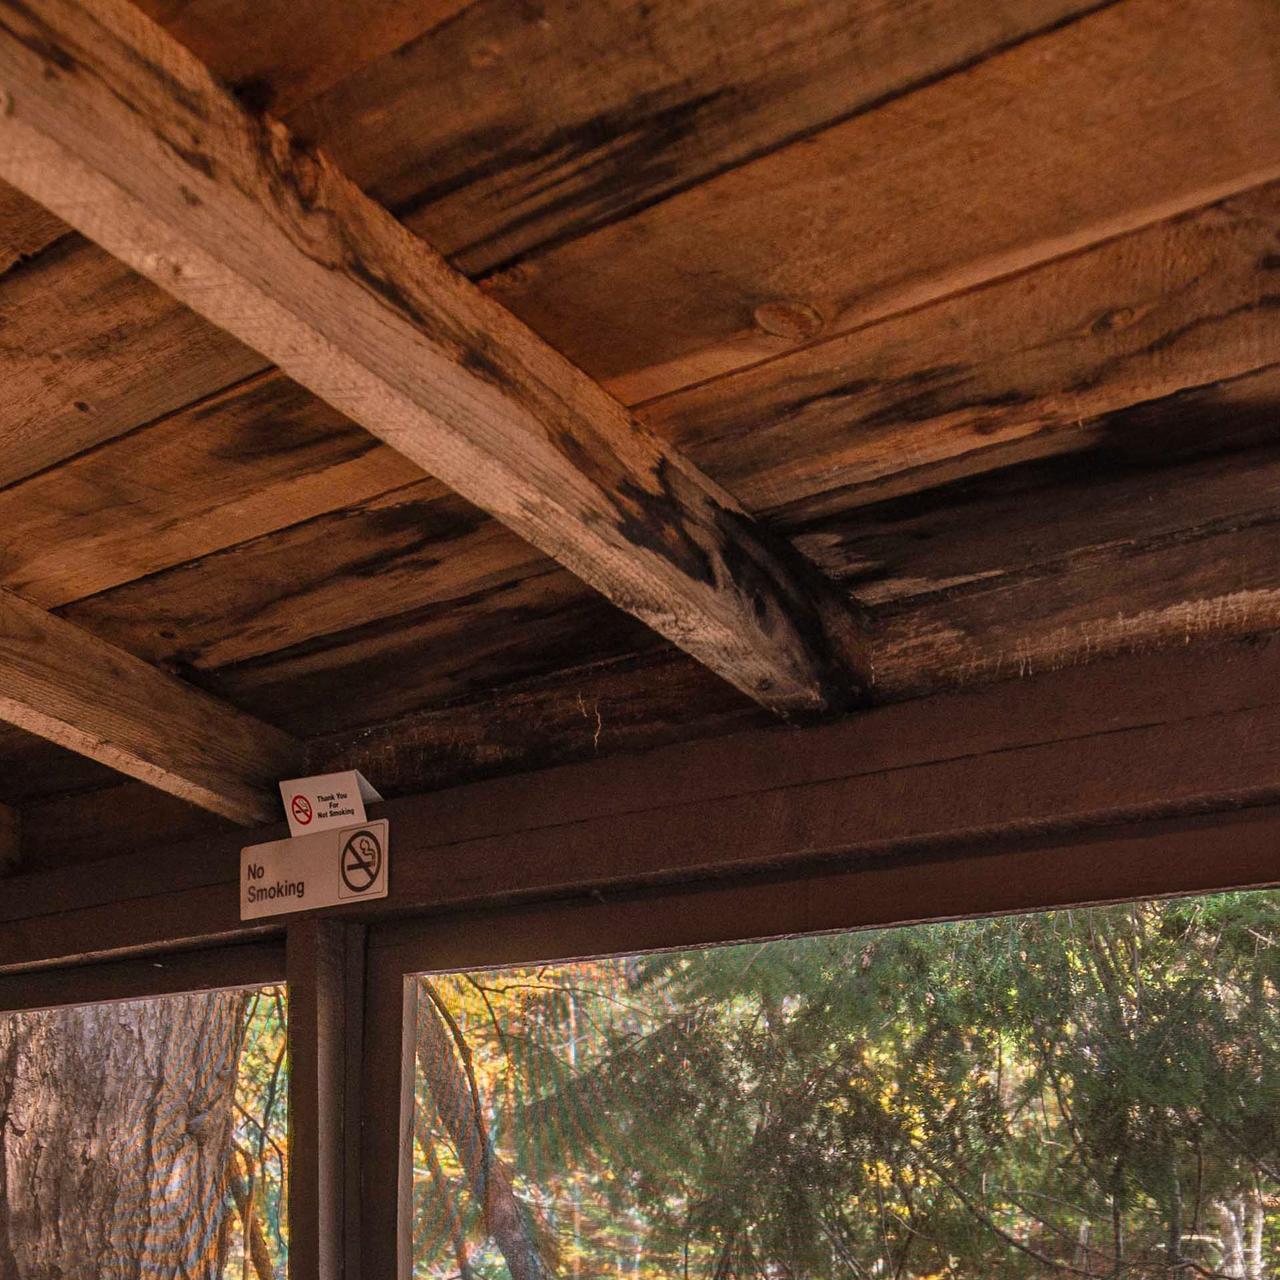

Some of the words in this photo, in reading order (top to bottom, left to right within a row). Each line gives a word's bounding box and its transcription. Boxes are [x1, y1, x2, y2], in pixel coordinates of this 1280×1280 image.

[317, 793, 335, 803] Thank
[336, 792, 348, 800] You
[329, 801, 339, 809] For
[329, 808, 355, 818] Smoking
[247, 864, 265, 880] No
[247, 881, 305, 903] Smoking
